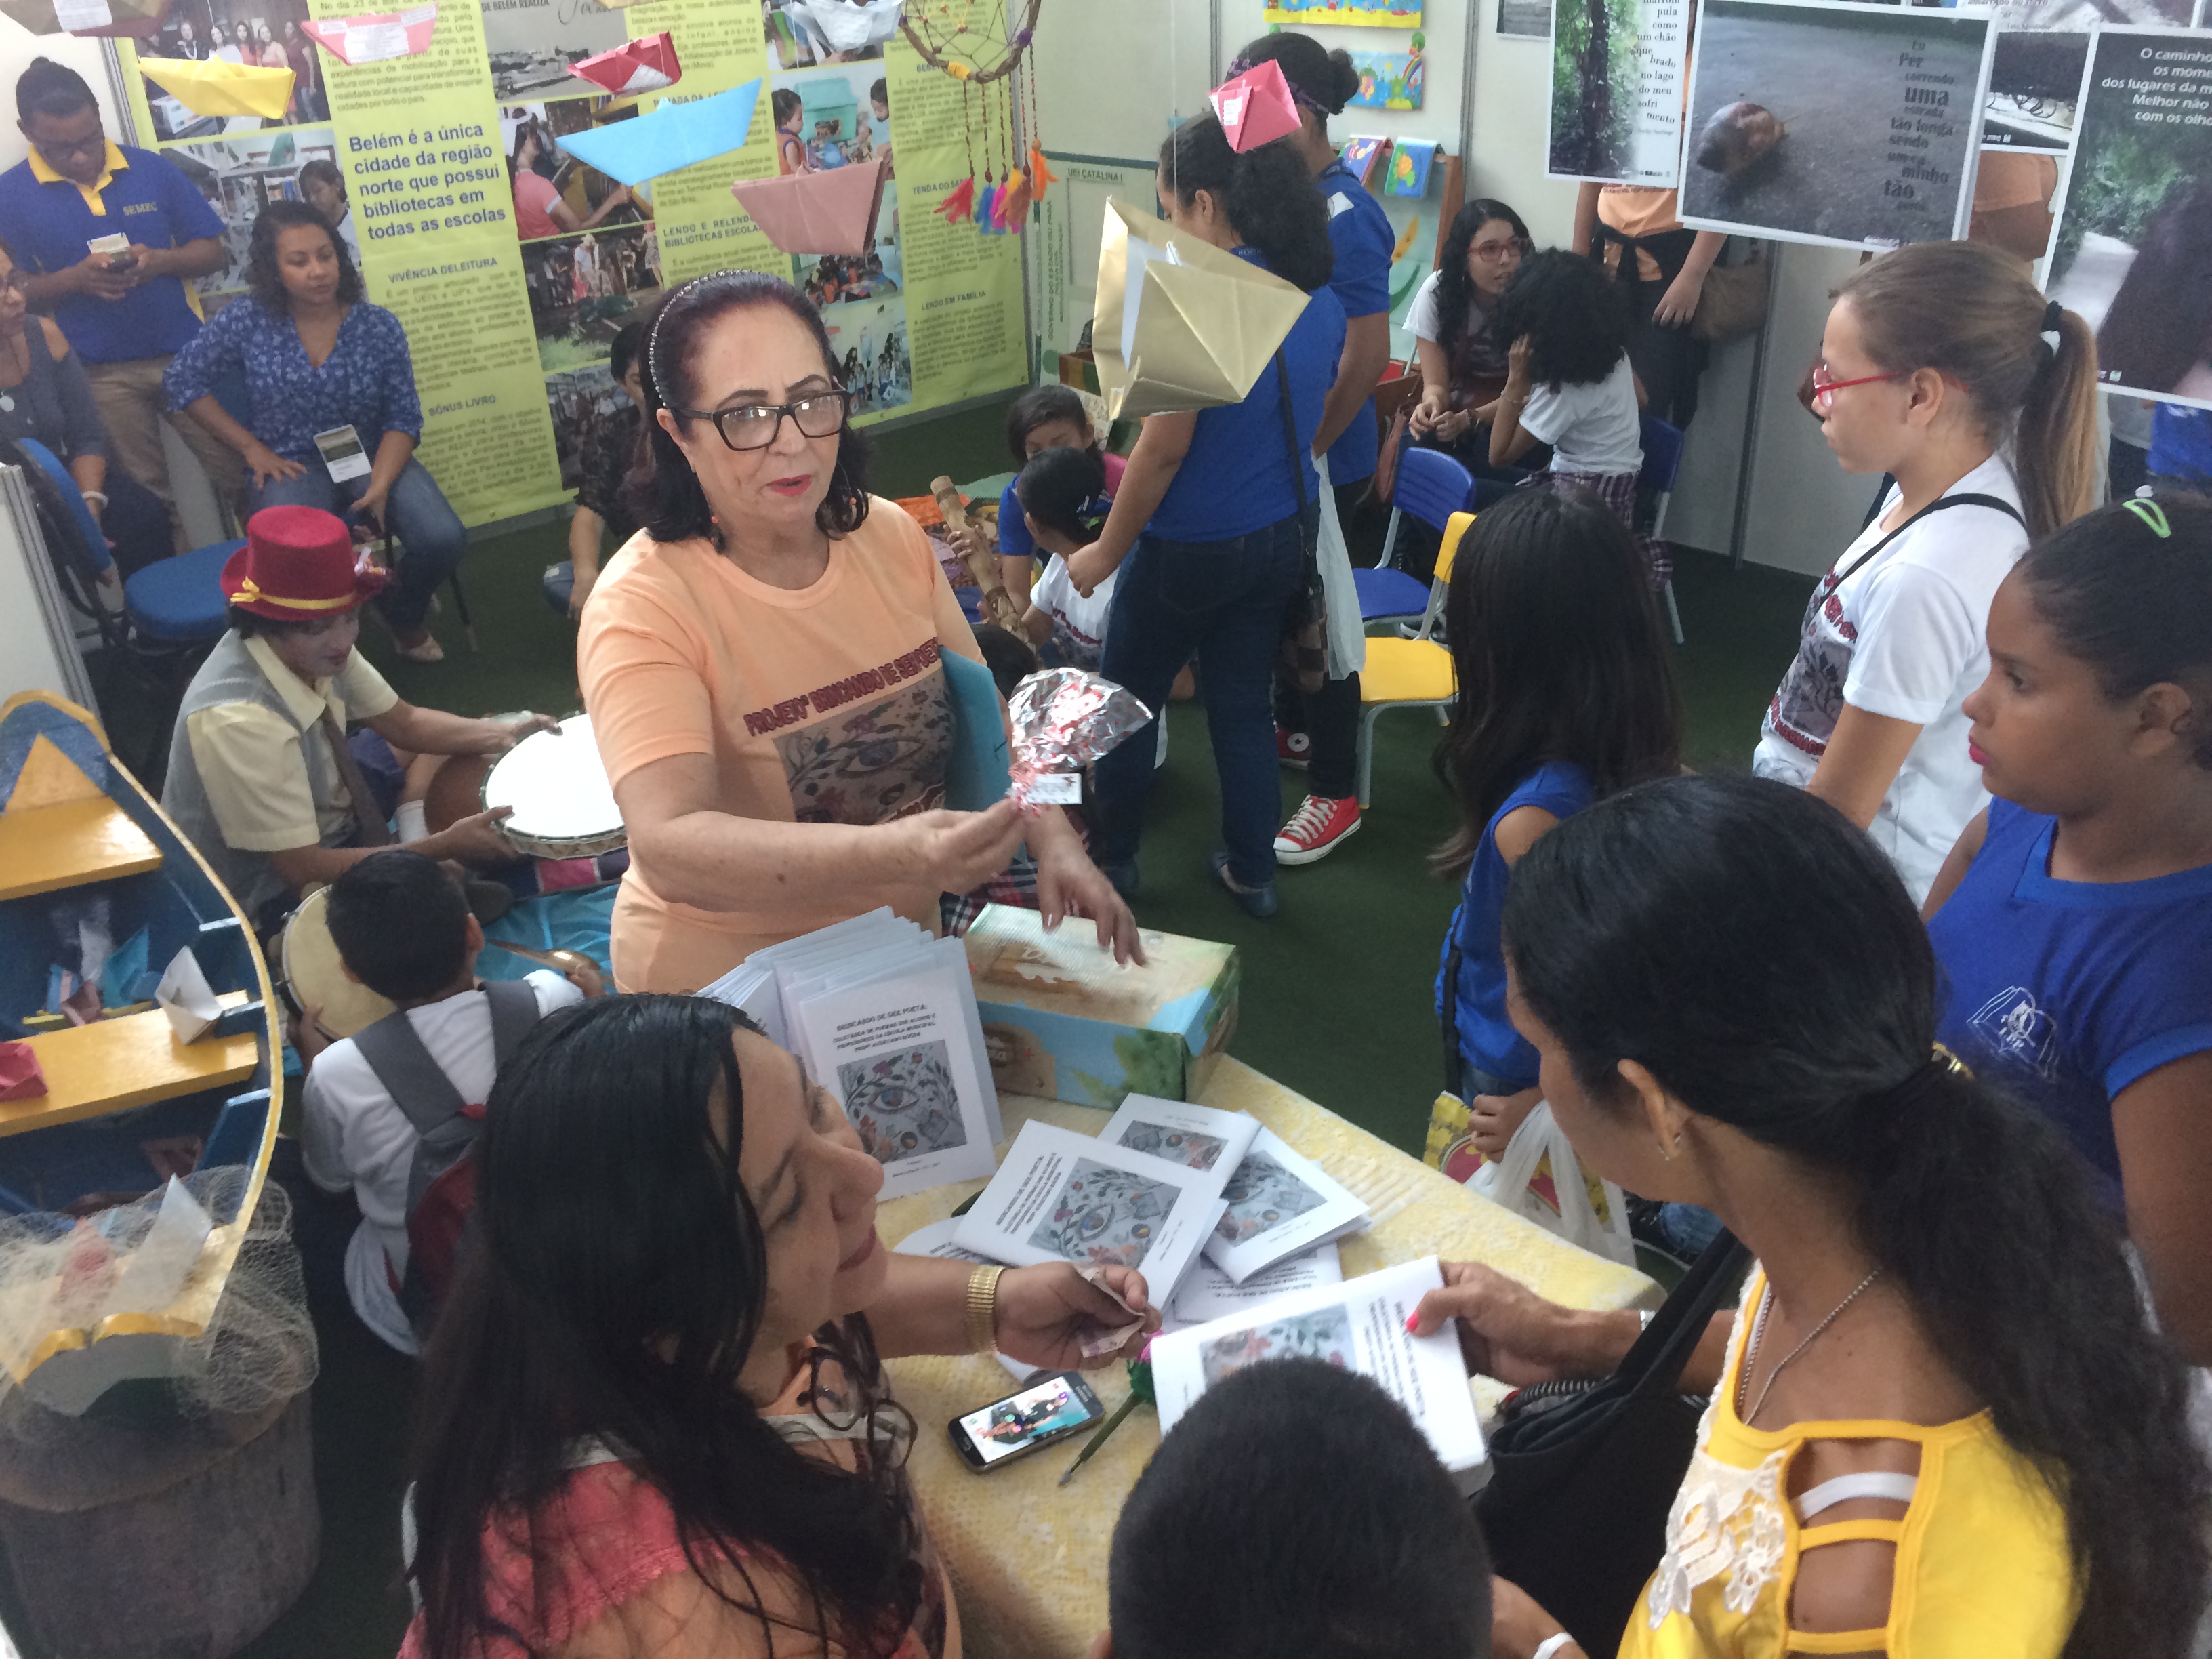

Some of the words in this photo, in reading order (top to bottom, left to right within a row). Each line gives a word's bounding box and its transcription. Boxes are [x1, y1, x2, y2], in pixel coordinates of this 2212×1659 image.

[1657, 7, 1677, 18] pula
[1654, 32, 1676, 41] chão
[1636, 48, 1653, 58] que
[1650, 54, 1676, 68] brado
[1899, 52, 1923, 68] Per
[2140, 47, 2153, 59] O
[1655, 70, 1674, 82] lago
[1905, 72, 1954, 85] correndo
[2153, 66, 2169, 76] os
[1639, 85, 1650, 94] do
[2102, 77, 2125, 89] dos
[2127, 78, 2175, 94] lugares
[2179, 81, 2196, 93] da
[1638, 99, 1658, 108] sofri
[1904, 87, 1949, 106] uma
[2133, 94, 2177, 107] Melhor
[2182, 97, 2209, 110] não
[1647, 111, 1675, 123] mento
[1891, 117, 1912, 131] tão
[2135, 111, 2163, 122] com
[2166, 113, 2181, 123] os
[349, 132, 403, 152] Belém
[408, 129, 418, 144] é
[424, 131, 433, 143] a
[438, 124, 483, 141] única
[1889, 134, 1929, 148] sendo
[354, 154, 411, 174] cidade
[415, 150, 436, 166] da
[441, 144, 493, 164] região
[359, 178, 403, 197] norte
[409, 175, 438, 192] que
[444, 163, 499, 188] possui
[1082, 169, 1118, 182] CATALINA
[1902, 165, 1948, 184] minho
[914, 184, 937, 194] TENDA
[939, 182, 949, 190] DO
[1884, 179, 1914, 199] tão
[363, 194, 454, 219] bibliotecas
[459, 190, 484, 204] em
[368, 222, 415, 240] todas
[421, 218, 439, 232] as
[444, 208, 506, 228] escolas
[663, 224, 696, 237] LENDO
[714, 215, 752, 228] RELEND
[665, 230, 723, 248] BIBLIOTECAS
[388, 266, 438, 283] VIVÊNCIA
[922, 298, 943, 310] LENDO
[945, 295, 955, 305] EM
[957, 290, 986, 302] FAMÍLIA
[429, 401, 463, 416] BÔNUS
[465, 395, 496, 407] LIVRO
[809, 669, 885, 713] BRINCANDO
